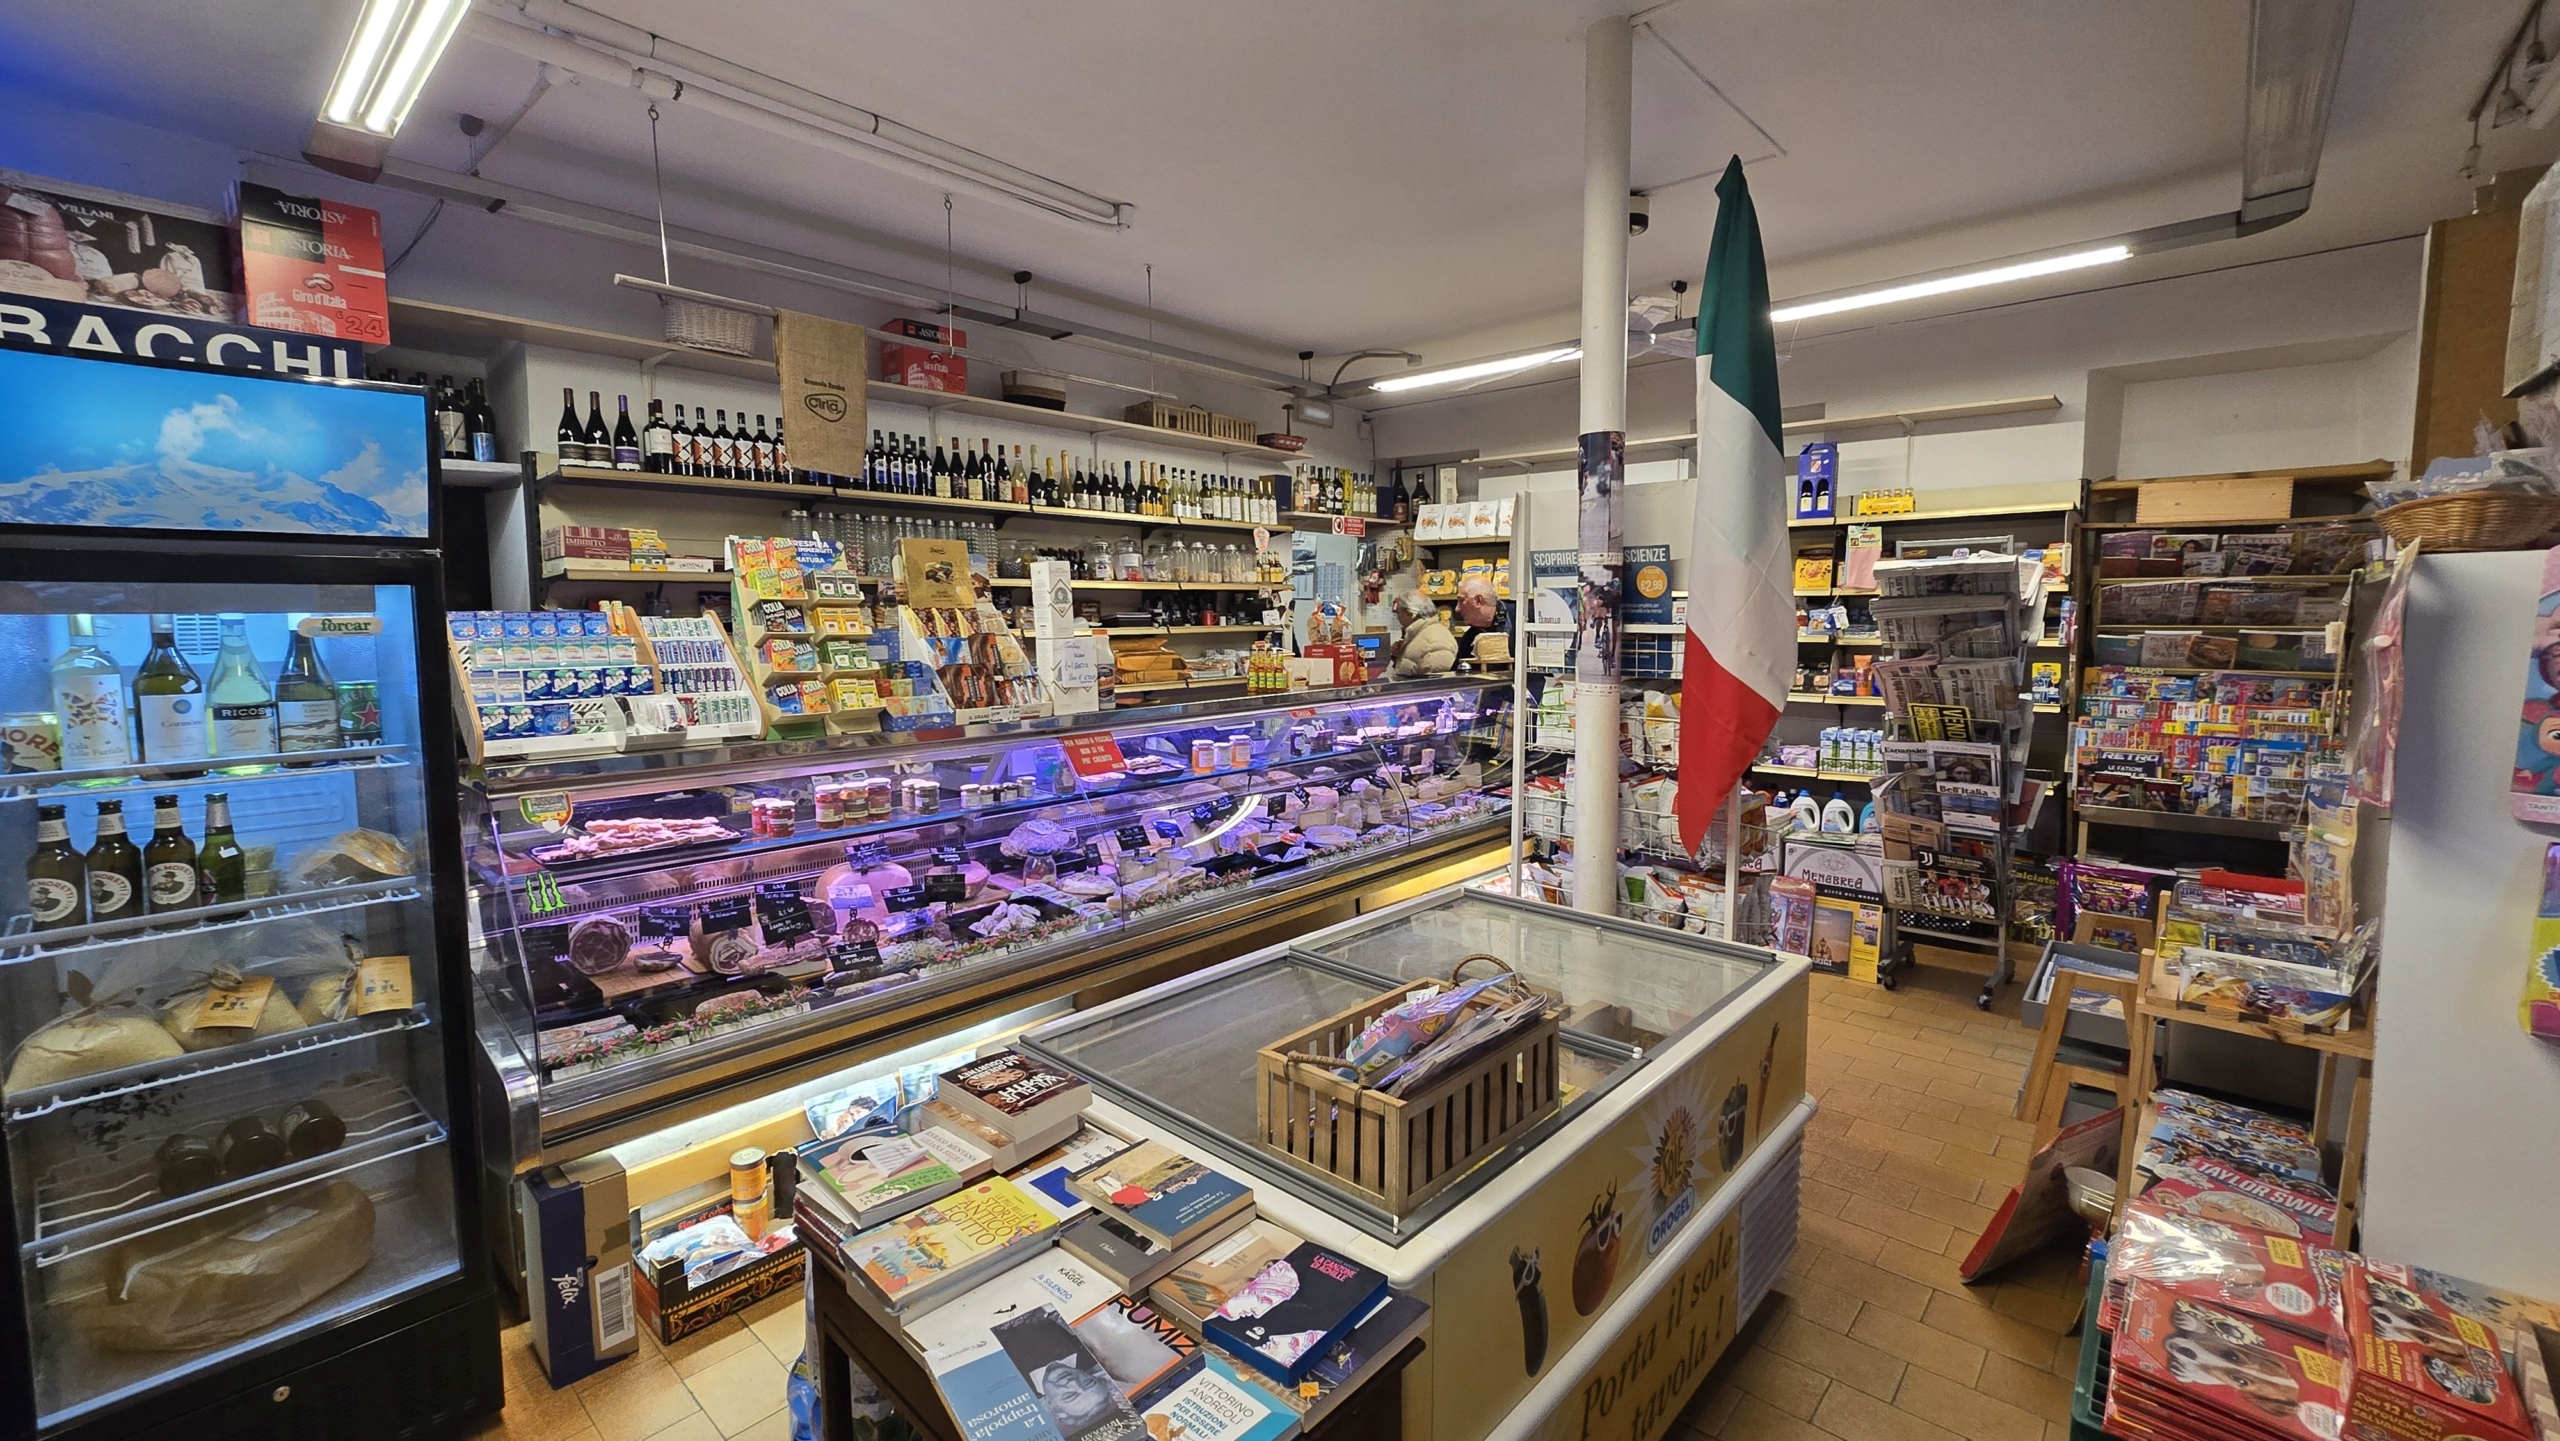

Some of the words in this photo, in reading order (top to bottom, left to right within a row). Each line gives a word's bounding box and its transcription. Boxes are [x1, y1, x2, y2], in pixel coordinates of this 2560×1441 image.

[57, 202, 114, 220] VILLANI
[274, 200, 350, 225] ASTORIA
[292, 288, 315, 304] Giro
[315, 290, 347, 310] d'Italia
[917, 327, 950, 341] ASTORIA
[566, 537, 606, 548] IMBIBITO
[796, 556, 826, 564] NATURA
[1534, 552, 1578, 566] SCOPRIRE
[1624, 547, 1667, 563] SCIENZE
[320, 618, 371, 632] forcar
[2124, 666, 2164, 676] MAGICO
[1943, 709, 1967, 741] VEND
[2262, 756, 2289, 765] PUZZLE
[1939, 785, 1989, 797] Bell'Italia
[1801, 868, 1864, 890] MENABREA
[958, 1058, 1004, 1081] COURTNEY
[1000, 1073, 1065, 1103] WILBUR
[2197, 1161, 2273, 1199] TAYLOR
[2268, 1189, 2338, 1223] SWIFT
[677, 1217, 697, 1231] Fior
[959, 1199, 1013, 1237] ANTICO
[981, 1197, 1020, 1227] STORIE
[1652, 1196, 1690, 1245] OROGEL
[941, 1204, 996, 1246] EGITTO
[1057, 1267, 1086, 1287] KAGGE
[1312, 1254, 1323, 1264] LA
[1322, 1258, 1357, 1278] CANZONE
[1318, 1265, 1350, 1282] ACHILLE
[1043, 1278, 1073, 1300] SILENZIO
[1107, 1293, 1201, 1358] RUMIZ
[1580, 1322, 1658, 1440] Porta
[1665, 1279, 1687, 1340] il
[1692, 1228, 1735, 1298] sole
[1630, 1326, 1710, 1441] tavola
[1188, 1387, 1243, 1425] ANDREOLI
[1199, 1377, 1255, 1418] VITTORINO
[967, 1391, 1031, 1429] amorosa
[974, 1402, 1039, 1440] trappola
[1022, 1414, 1046, 1429] La
[1174, 1403, 1190, 1416] PER
[1188, 1411, 1221, 1437] ESSERE
[1182, 1397, 1229, 1431] ISTRUZIONI
[2355, 1391, 2380, 1405] CON
[2403, 1411, 2442, 1433] NUOVI
